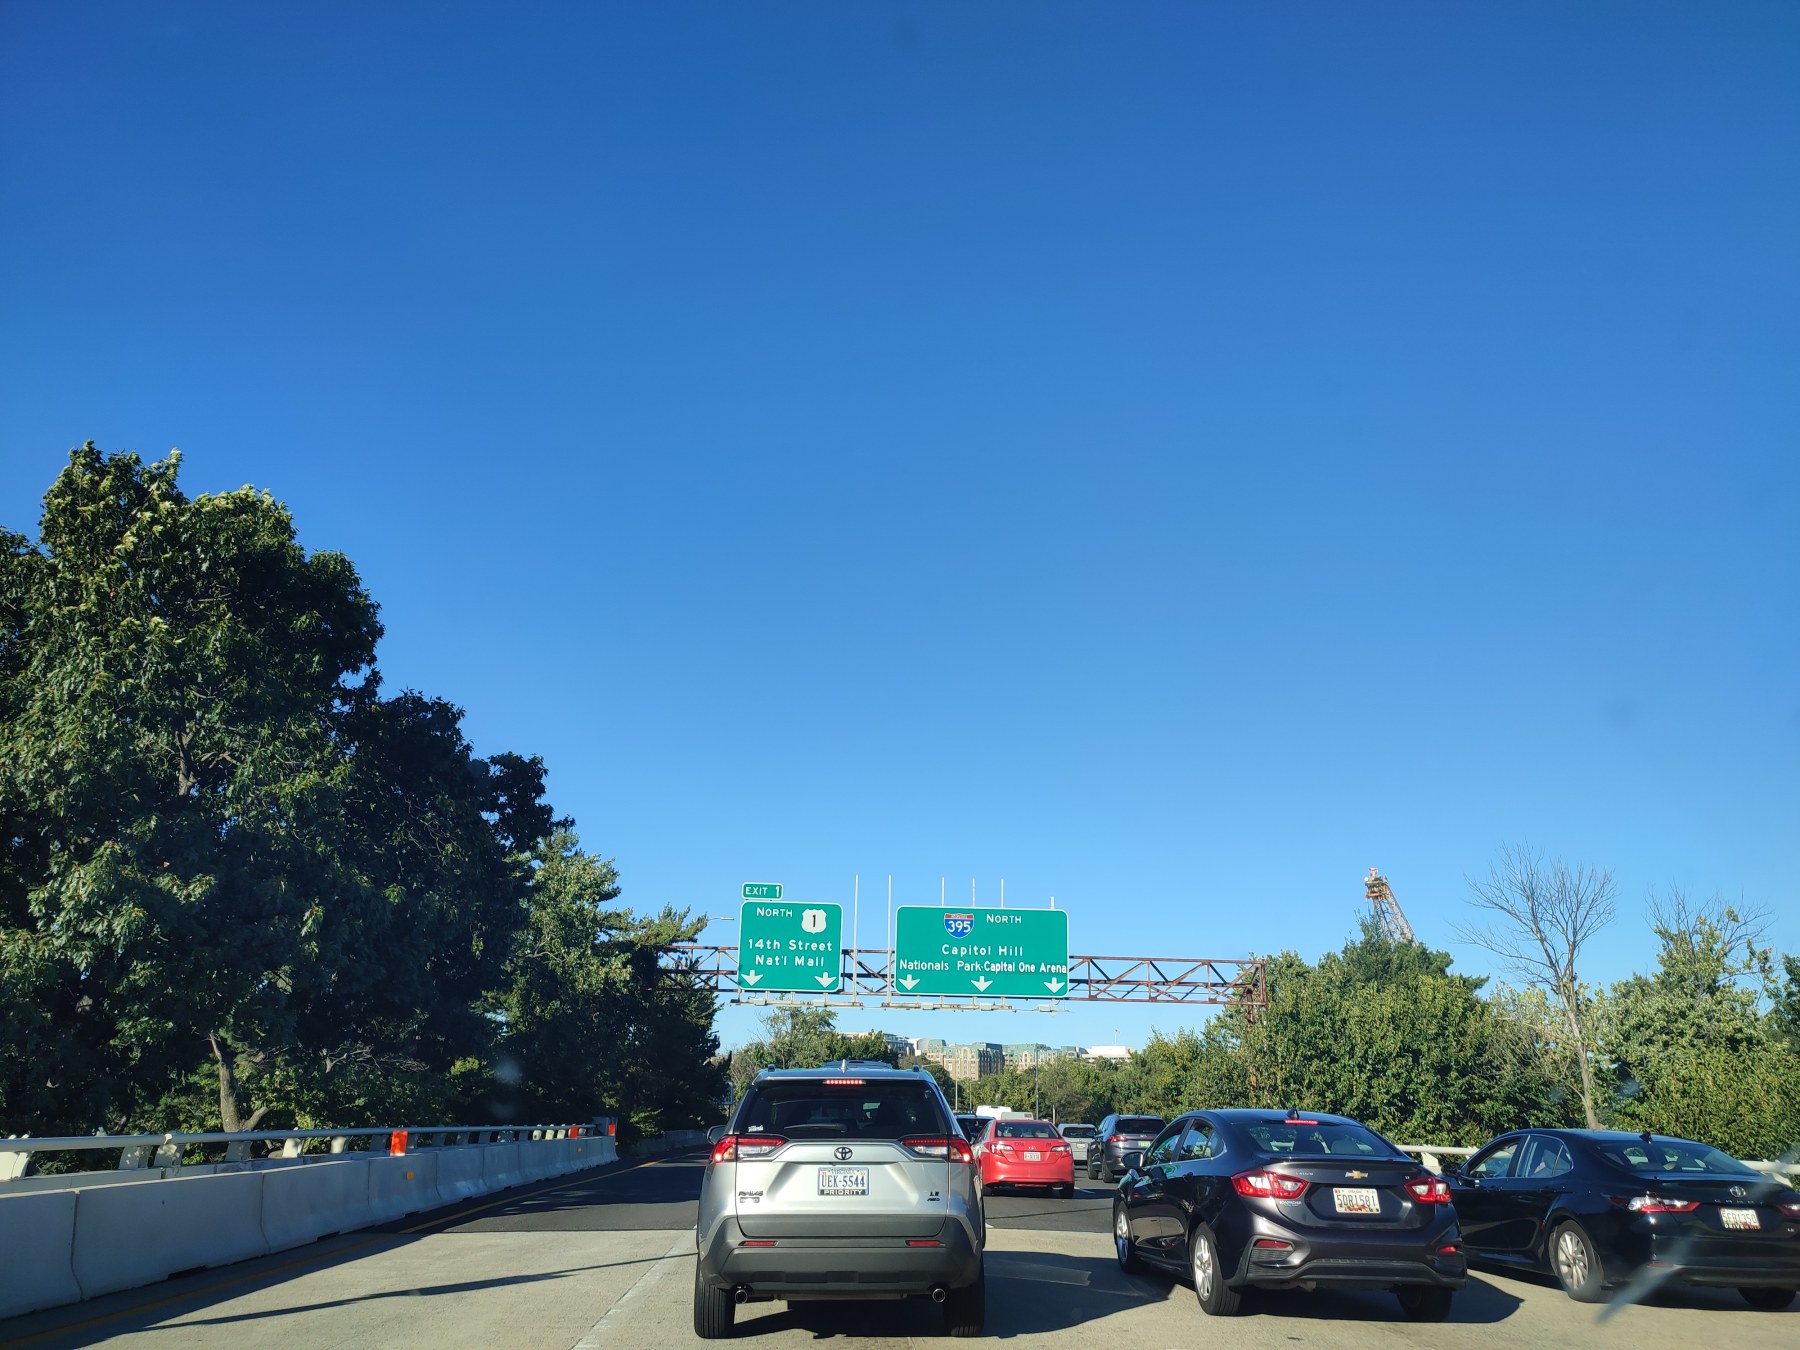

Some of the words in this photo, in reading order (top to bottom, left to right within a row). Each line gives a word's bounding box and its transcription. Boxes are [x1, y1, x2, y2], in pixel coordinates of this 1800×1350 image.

[745, 886, 768, 895] EXIT
[775, 885, 780, 898] 1
[756, 907, 793, 918] NORTH
[986, 914, 1022, 924] NORTH
[812, 914, 817, 928] 1
[947, 920, 971, 933] 395
[748, 938, 781, 950] 14th
[788, 939, 833, 952] Street
[941, 943, 991, 958] Capitol
[998, 945, 1023, 957] Hill
[755, 954, 787, 966] Nat'l
[794, 955, 825, 967] Mall
[899, 959, 950, 971] Nationals
[1018, 961, 1036, 973] One
[1039, 962, 1067, 974] Arena
[821, 1174, 865, 1188] UEK-5544
